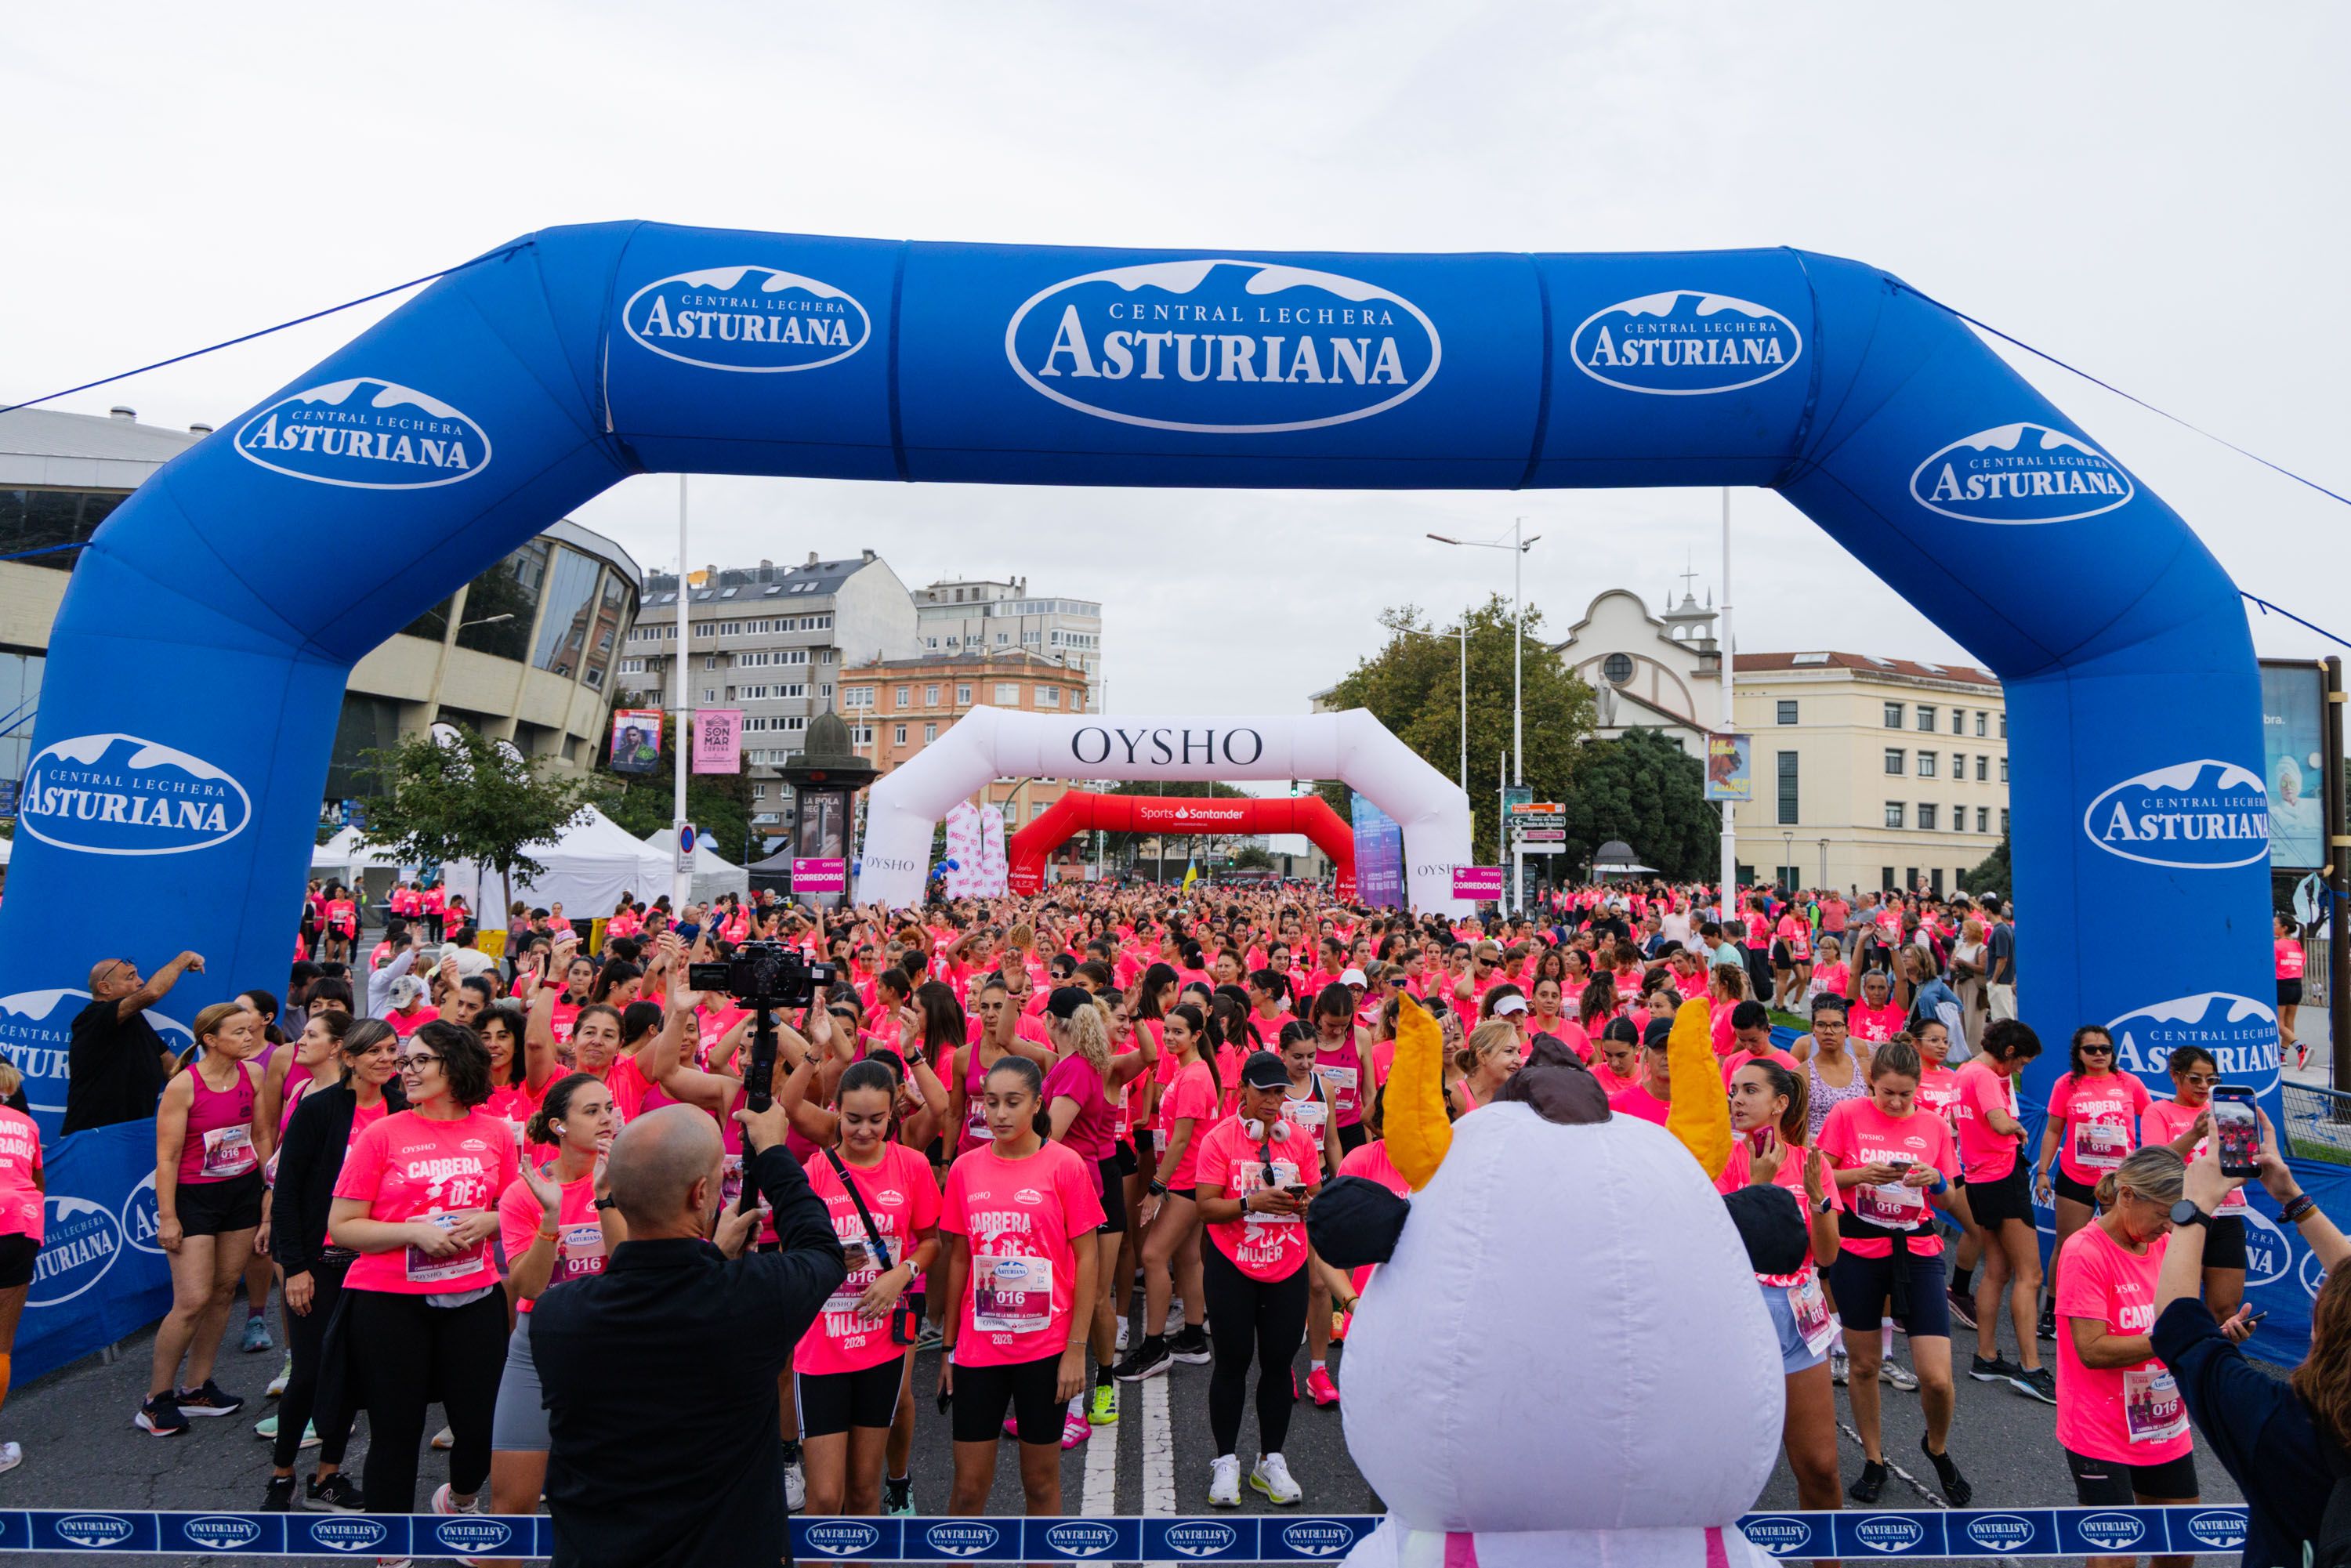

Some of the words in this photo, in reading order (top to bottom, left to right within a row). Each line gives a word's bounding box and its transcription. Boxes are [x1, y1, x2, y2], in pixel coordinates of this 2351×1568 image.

[682, 295, 759, 308] CENTRAL
[767, 299, 845, 313] LECHERA
[641, 295, 852, 346] ASTURIANA
[1109, 302, 1244, 322] CENTRAL
[1259, 307, 1394, 325] LECHERA
[1625, 324, 1697, 334] CENTRAL
[1704, 322, 1777, 333] LECHERA
[1038, 304, 1408, 385] ASTURIANA
[1588, 325, 1784, 367] ASTURIANA
[292, 410, 368, 425] CENTRAL
[376, 415, 463, 436] LECHERA
[245, 413, 470, 470] ASTURIANA
[1970, 456, 2043, 469] CENTRAL
[2049, 456, 2109, 469] LECHERA
[1929, 462, 2126, 502] ASTURIANA
[705, 727, 730, 736] SON
[1071, 727, 1262, 765] OYSHO
[50, 770, 123, 787] CENTRAL
[132, 777, 226, 797] LECHERA
[24, 770, 229, 833] ASTURIANA
[2142, 798, 2219, 809] CENTRAL
[2224, 798, 2267, 808] LECHERA
[1140, 807, 1173, 820] Sports
[1190, 808, 1244, 820] Santander
[2103, 801, 2269, 841] ASTURIANA
[866, 856, 915, 872] OYSHO
[793, 873, 844, 882] CORREDORAS
[0, 1024, 71, 1043] CENTRAL
[2150, 1030, 2227, 1041] CENTRAL
[2234, 1027, 2277, 1040] LECHERA
[221, 1148, 239, 1158] 016
[402, 1143, 437, 1153] OYSHO
[2092, 1143, 2111, 1152] 016
[967, 1191, 991, 1203] OYSHO
[1876, 1202, 1902, 1214] 016
[64, 1216, 104, 1237] LECHERA
[567, 1233, 602, 1244] ASTURIANA
[1236, 1244, 1283, 1262] MUJER
[568, 1257, 601, 1273] 016
[416, 1271, 442, 1280] OYSHO
[996, 1291, 1025, 1304] 016
[1811, 1305, 1824, 1324] 016
[844, 1335, 865, 1349] 2026
[992, 1334, 1013, 1345] 2026
[2153, 1400, 2177, 1416] 016
[63, 1521, 127, 1537] ASTURIANA
[190, 1523, 255, 1537] ASTURIANA
[317, 1525, 380, 1540] ASTURIANA
[443, 1526, 505, 1541] ASTURIANA
[812, 1528, 874, 1544] ASTURIANA
[1288, 1529, 1348, 1544] ASTURIANA
[1749, 1526, 1805, 1541] ASTURIANA
[1861, 1524, 1918, 1539] ASTURIANA
[1972, 1523, 2028, 1537] ASTURIANA
[2084, 1522, 2139, 1536] ASTURIANA
[933, 1530, 994, 1544] ASTURIANA
[1052, 1530, 1114, 1544] ASTURIANA
[1171, 1530, 1231, 1544] ASTURIANA
